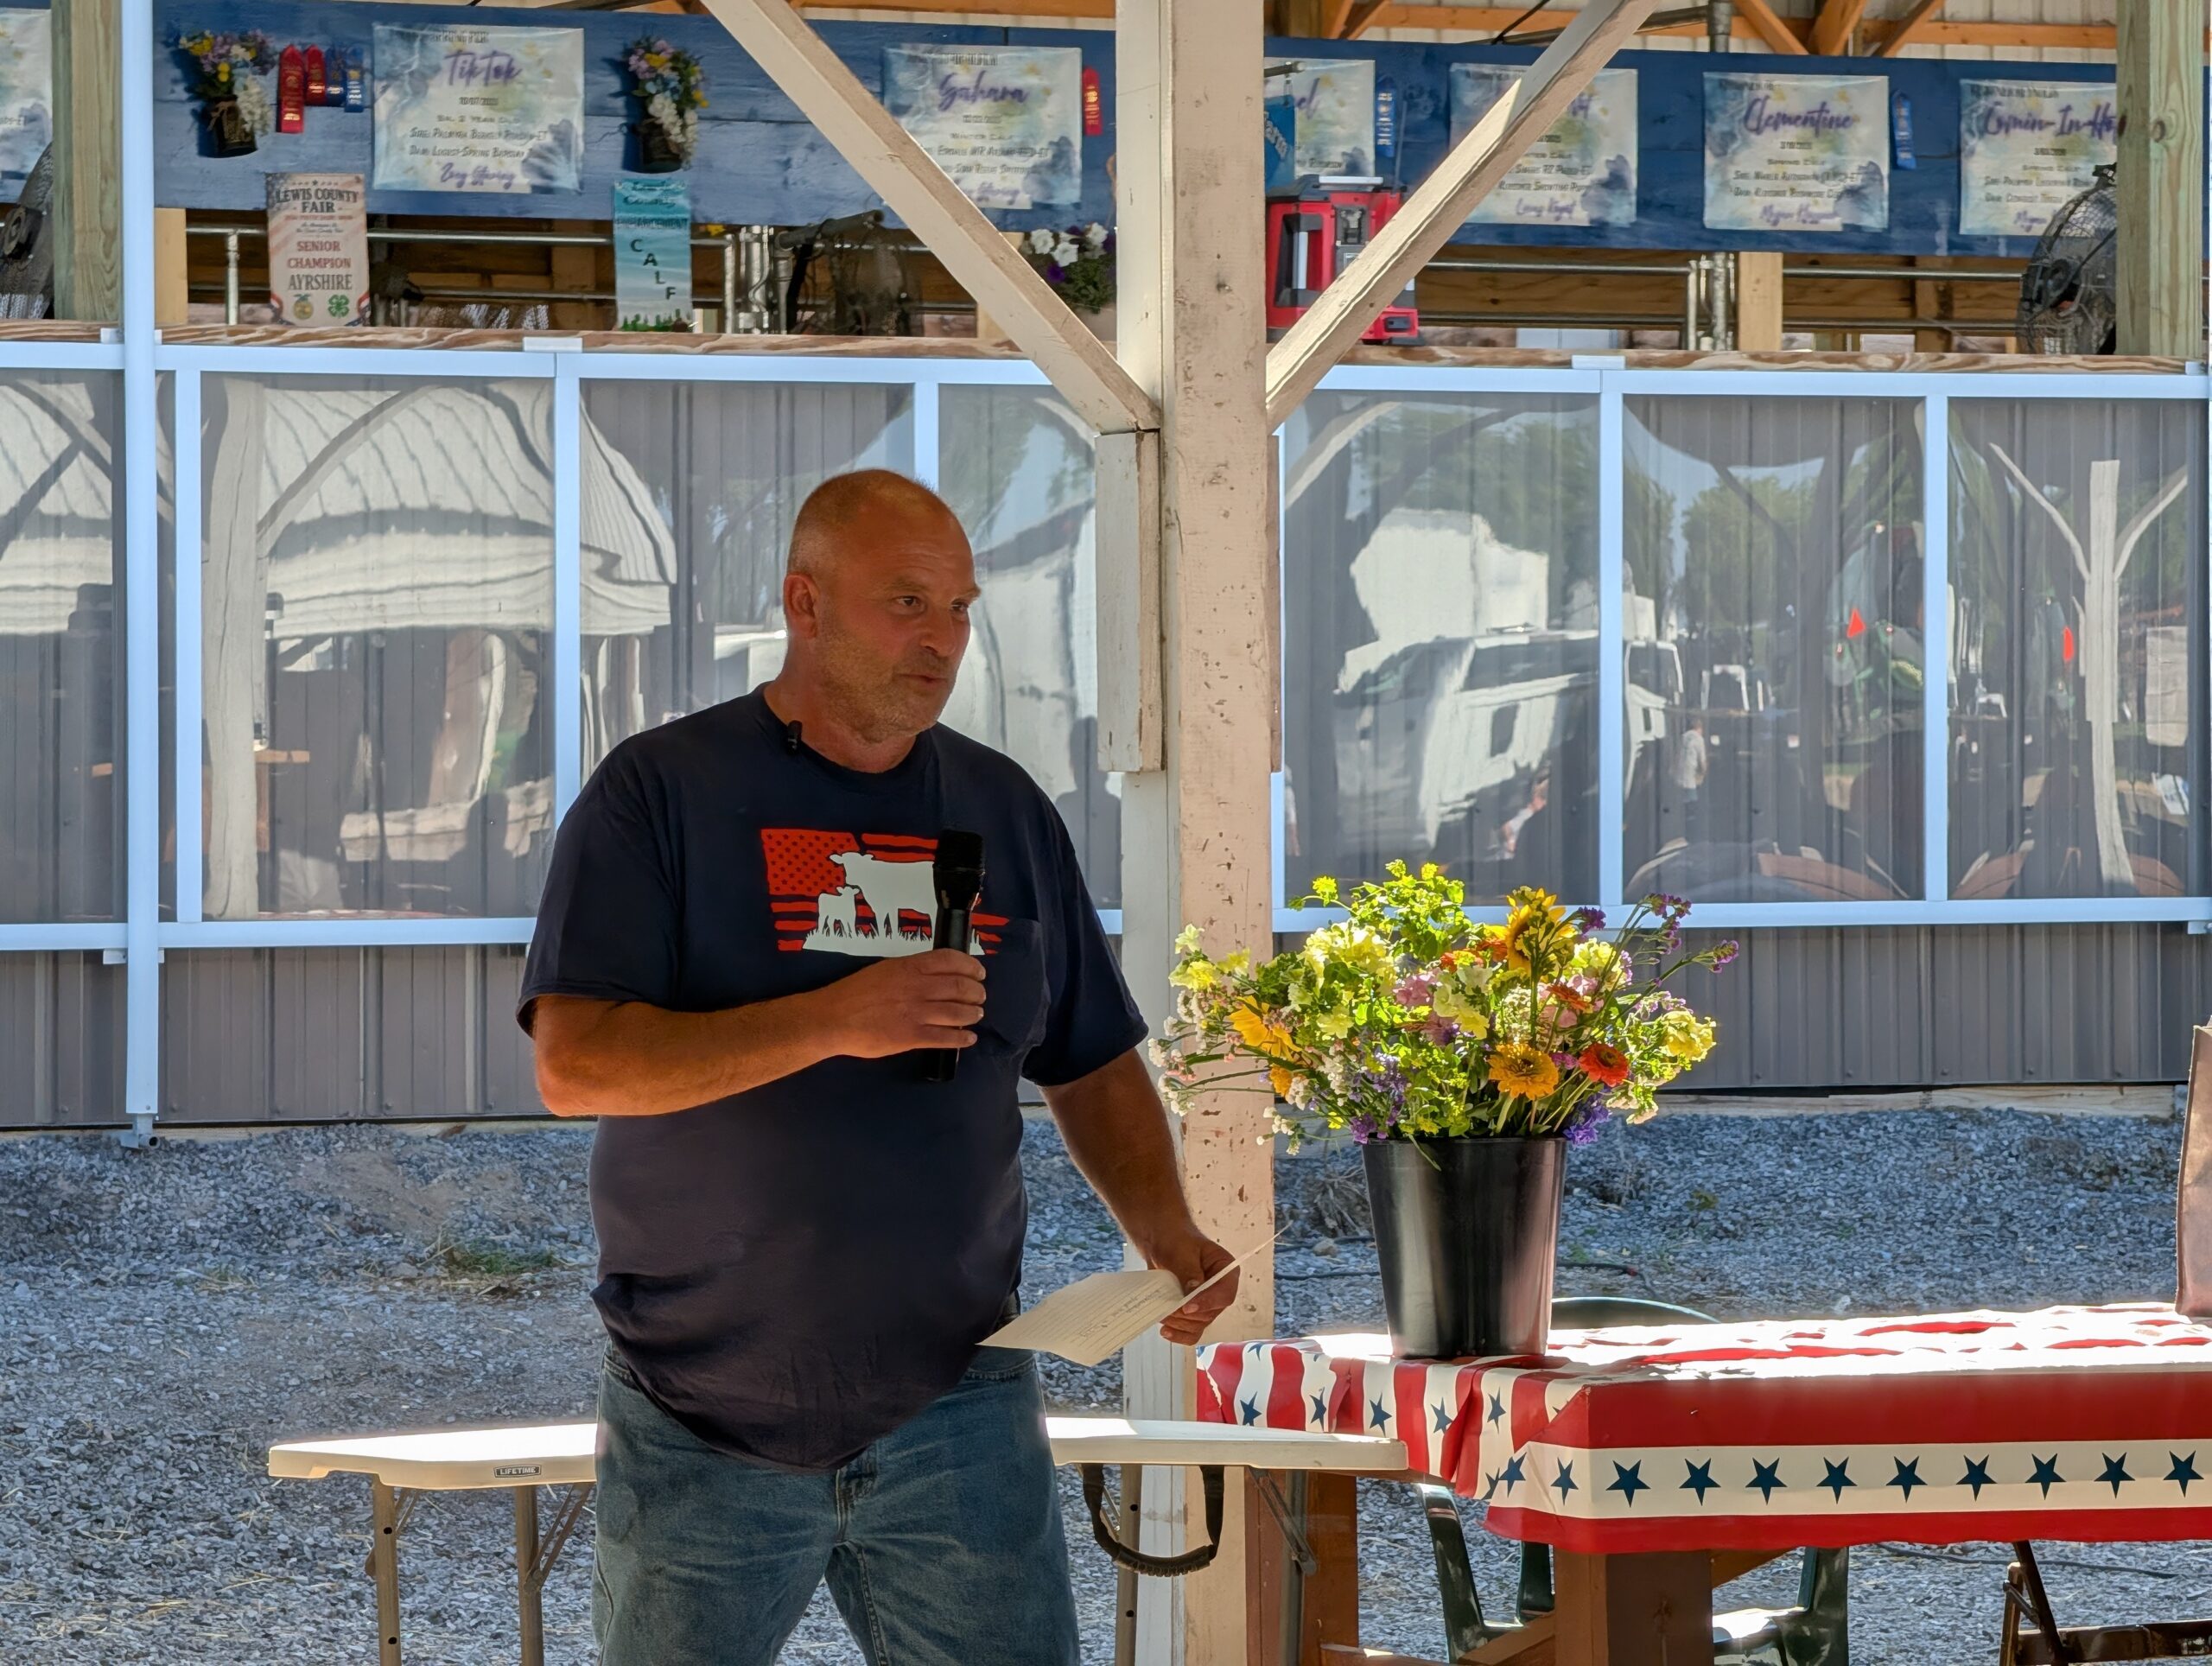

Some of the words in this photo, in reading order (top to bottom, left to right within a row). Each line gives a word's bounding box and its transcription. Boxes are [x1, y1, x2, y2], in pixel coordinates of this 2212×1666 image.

[1743, 95, 1854, 138] Clementine
[276, 188, 313, 204] LEWIS
[315, 188, 359, 203] COUNTY
[301, 201, 335, 213] FAIR
[296, 240, 341, 251] SENIOR
[287, 258, 352, 269] CHAMPION
[288, 274, 353, 290] AYRSHIRE
[499, 1466, 537, 1475] LIFETIME
